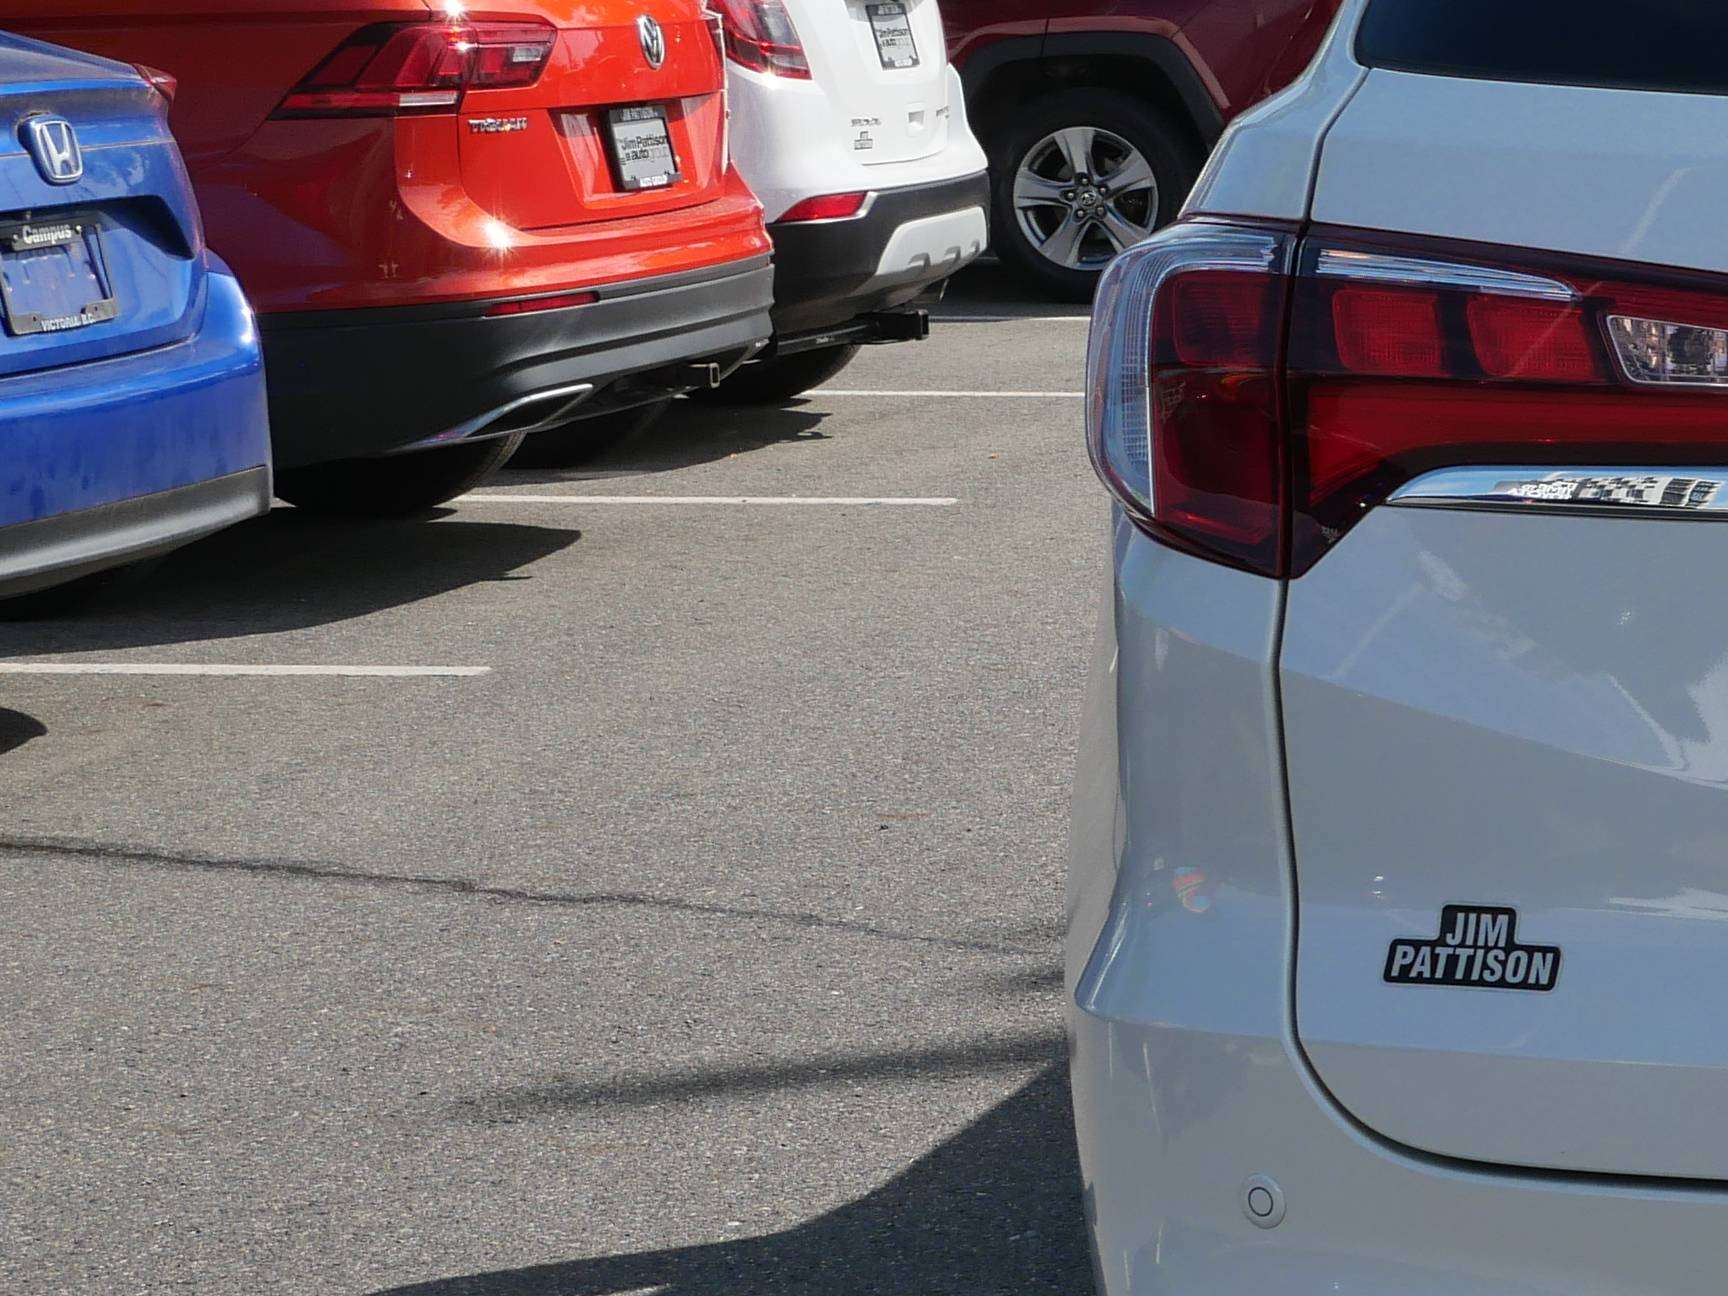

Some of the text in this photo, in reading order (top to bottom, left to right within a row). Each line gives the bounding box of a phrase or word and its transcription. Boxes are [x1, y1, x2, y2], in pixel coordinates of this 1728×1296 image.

[23, 224, 72, 245] Campus
[1446, 912, 1509, 947] JIM
[1391, 945, 1553, 985] PATTISON
